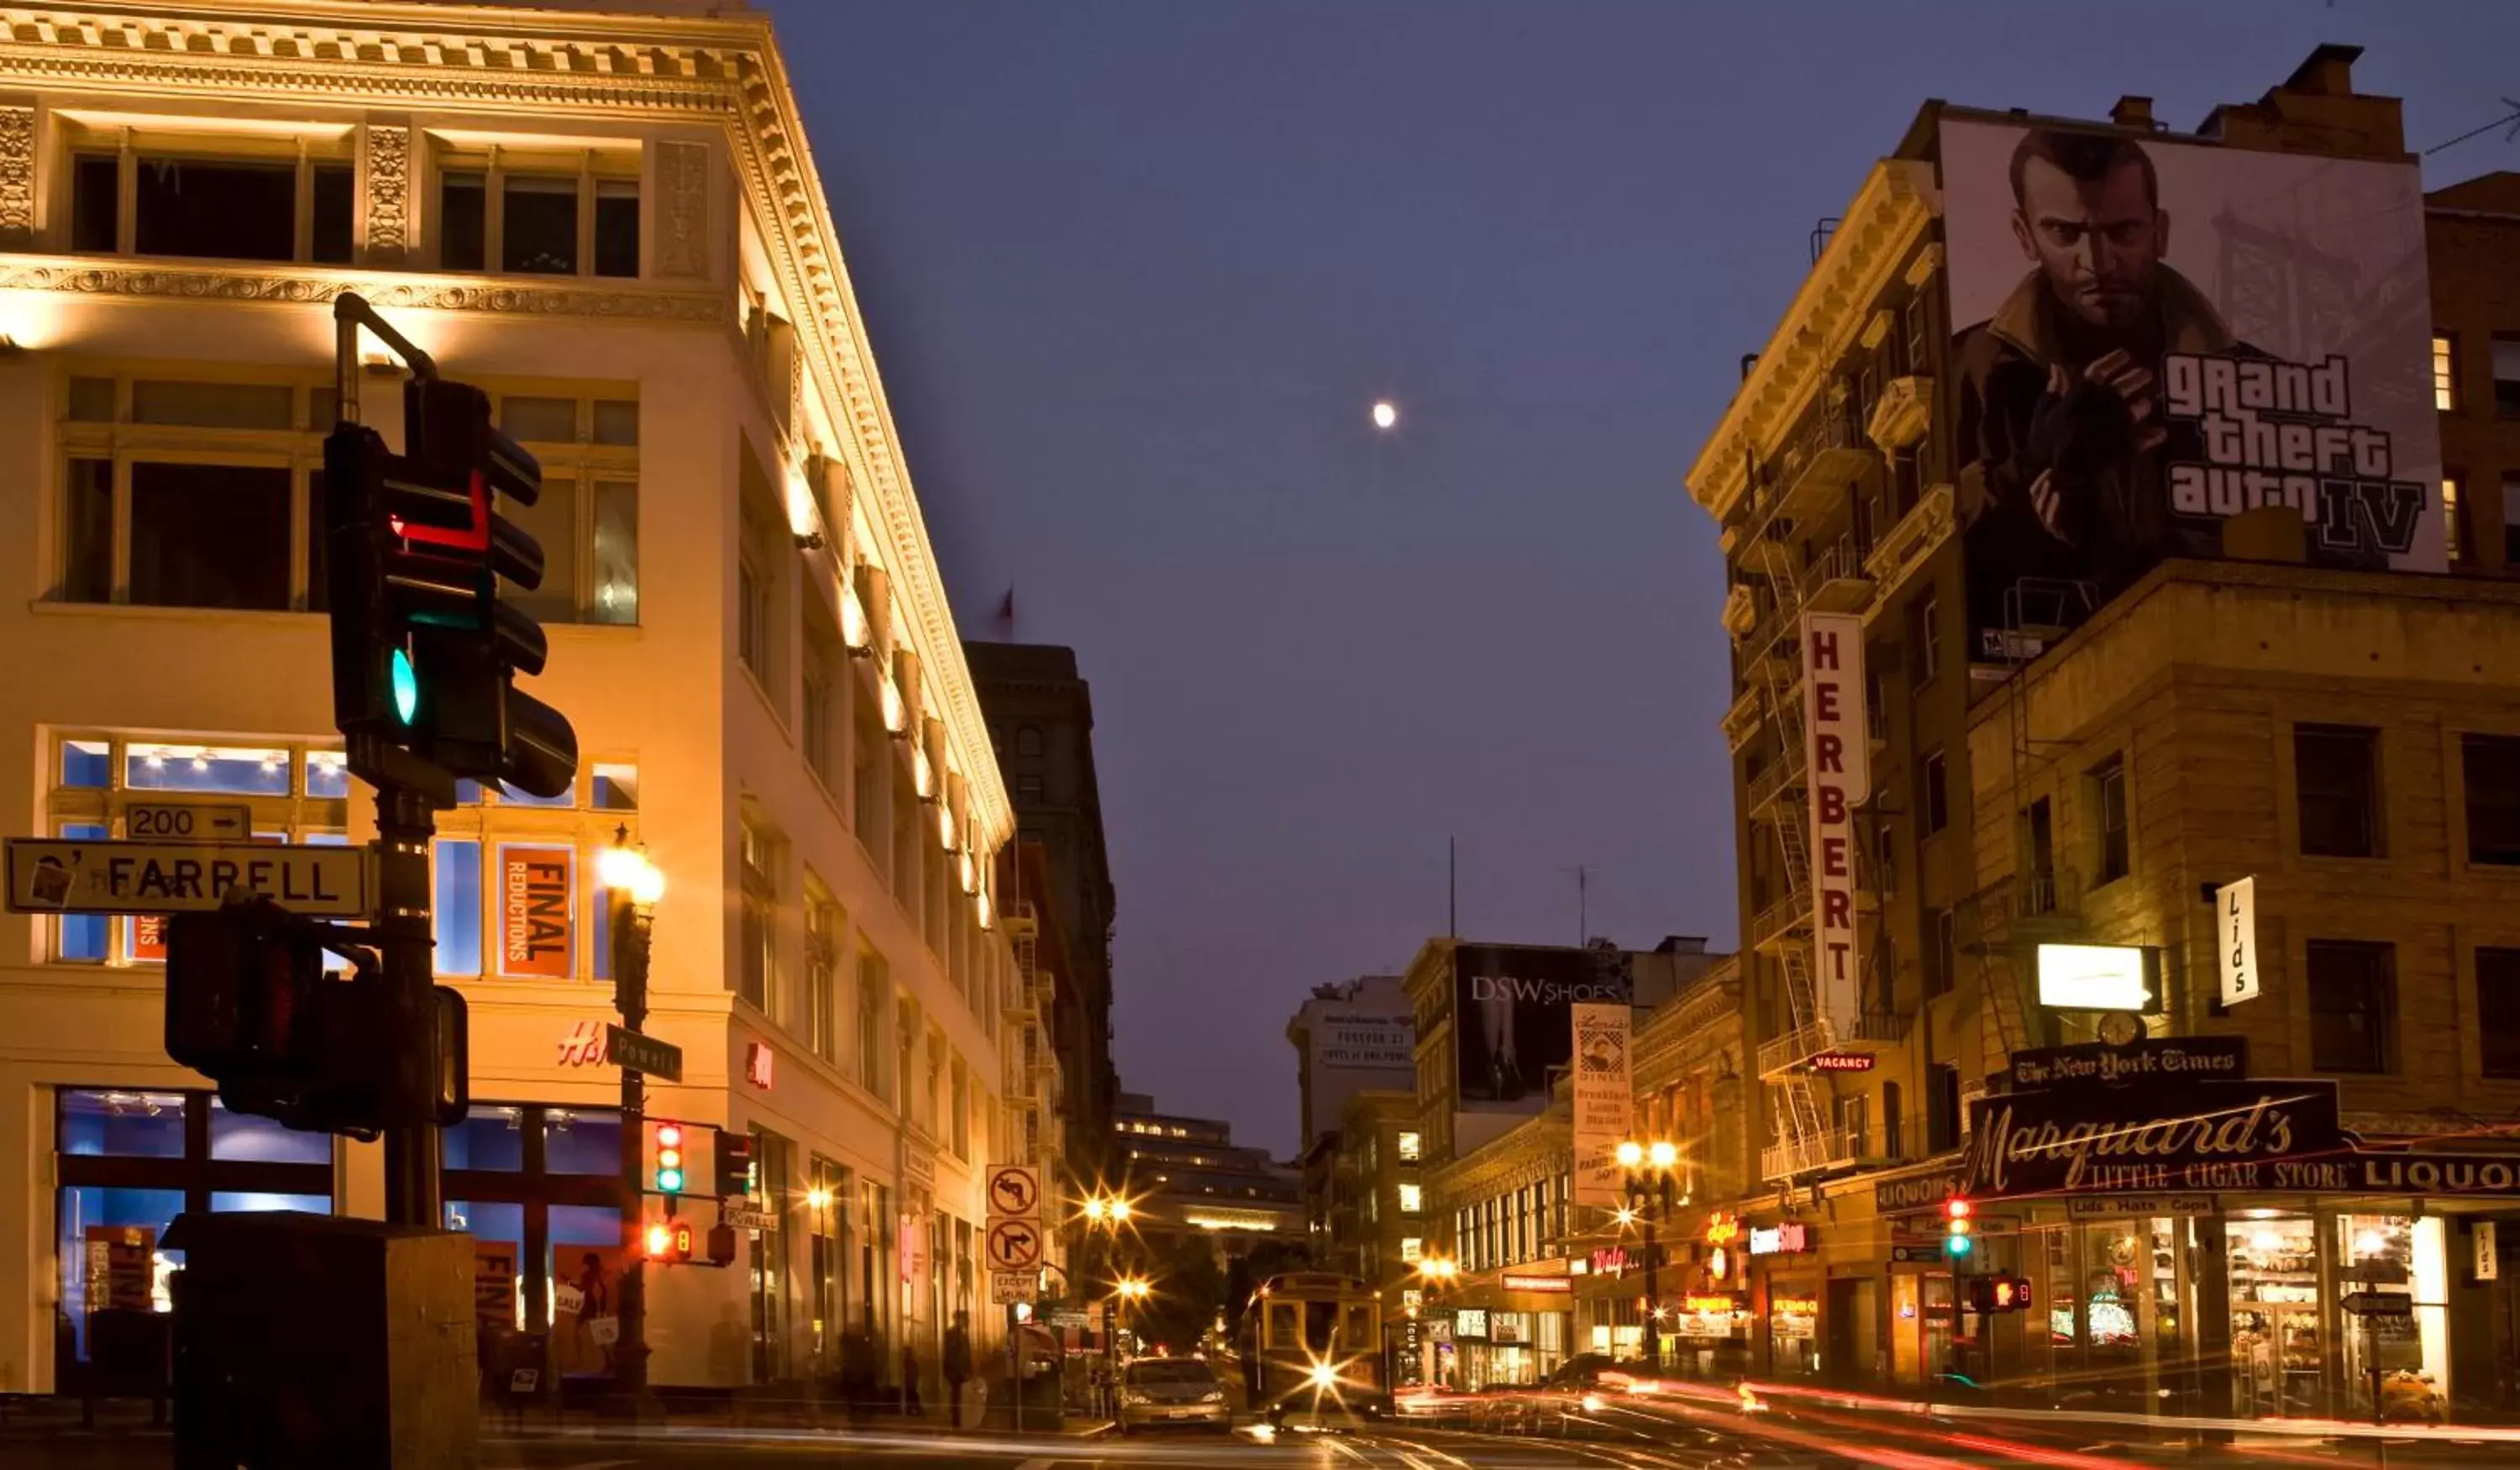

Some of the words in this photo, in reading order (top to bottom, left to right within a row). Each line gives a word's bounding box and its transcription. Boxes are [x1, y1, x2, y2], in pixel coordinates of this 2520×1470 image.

[2319, 477, 2427, 553] IV
[134, 809, 194, 835] 200
[1811, 631, 1851, 980] HERBERT
[108, 857, 340, 901] FARRELL
[508, 861, 527, 962] REDUCTIONS
[528, 863, 565, 961] FINAL
[2229, 891, 2245, 993] Lids
[1472, 975, 1545, 1002] DSW
[558, 1020, 622, 1068] H&
[618, 1037, 675, 1074] Powell
[1815, 1057, 1871, 1068] VACANCY
[2016, 1061, 2050, 1084] The
[2052, 1055, 2096, 1079] New
[2100, 1051, 2157, 1079] York
[2160, 1048, 2236, 1073] Times
[1964, 1095, 2292, 1191] Marquard's
[1879, 1174, 1957, 1206] LIQUORS
[2184, 1162, 2260, 1189] CIGAR
[2365, 1158, 2520, 1192] LIQUO
[727, 1210, 775, 1229] POWELL
[2074, 1200, 2104, 1213] Lids
[2117, 1200, 2157, 1212] Hats
[2171, 1197, 2208, 1212] Caps
[2480, 1231, 2489, 1273] Lids
